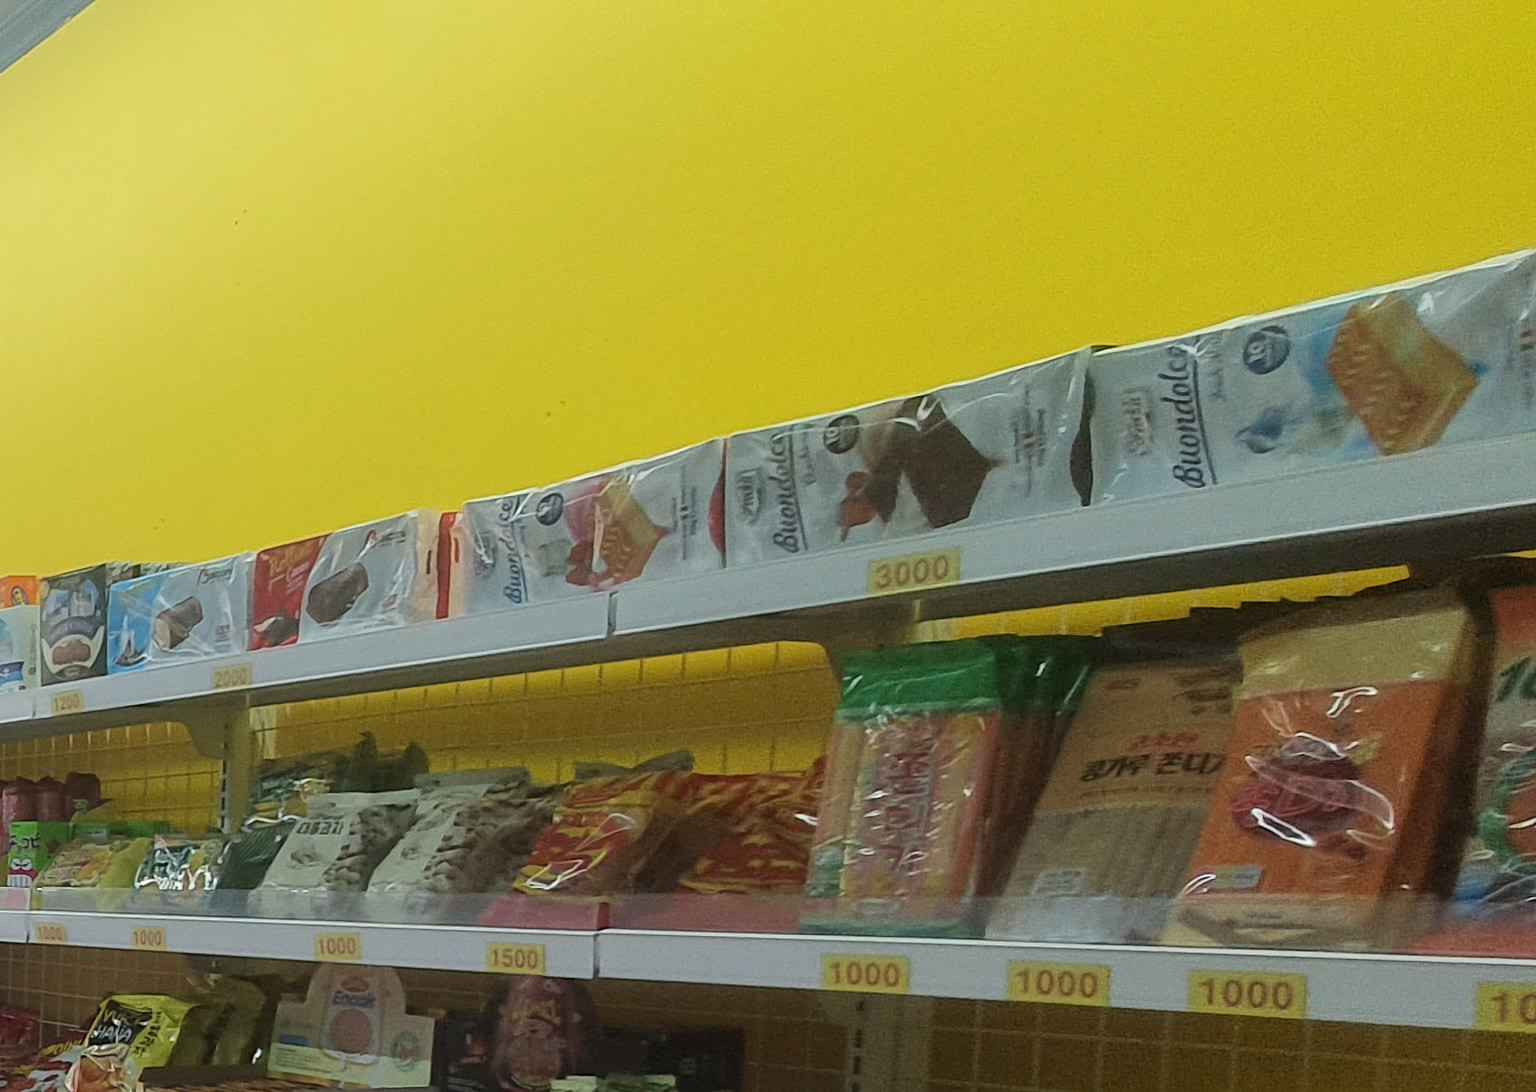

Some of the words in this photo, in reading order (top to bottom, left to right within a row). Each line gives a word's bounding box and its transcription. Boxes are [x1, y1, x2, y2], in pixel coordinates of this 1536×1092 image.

[875, 555, 949, 590] 3000
[214, 667, 248, 688] 2000
[133, 930, 162, 947] 1000
[317, 938, 356, 956] 1000
[492, 949, 538, 969] 1500
[830, 962, 900, 988] 1000
[1017, 971, 1098, 998] 1000
[1200, 980, 1294, 1010] 1000
